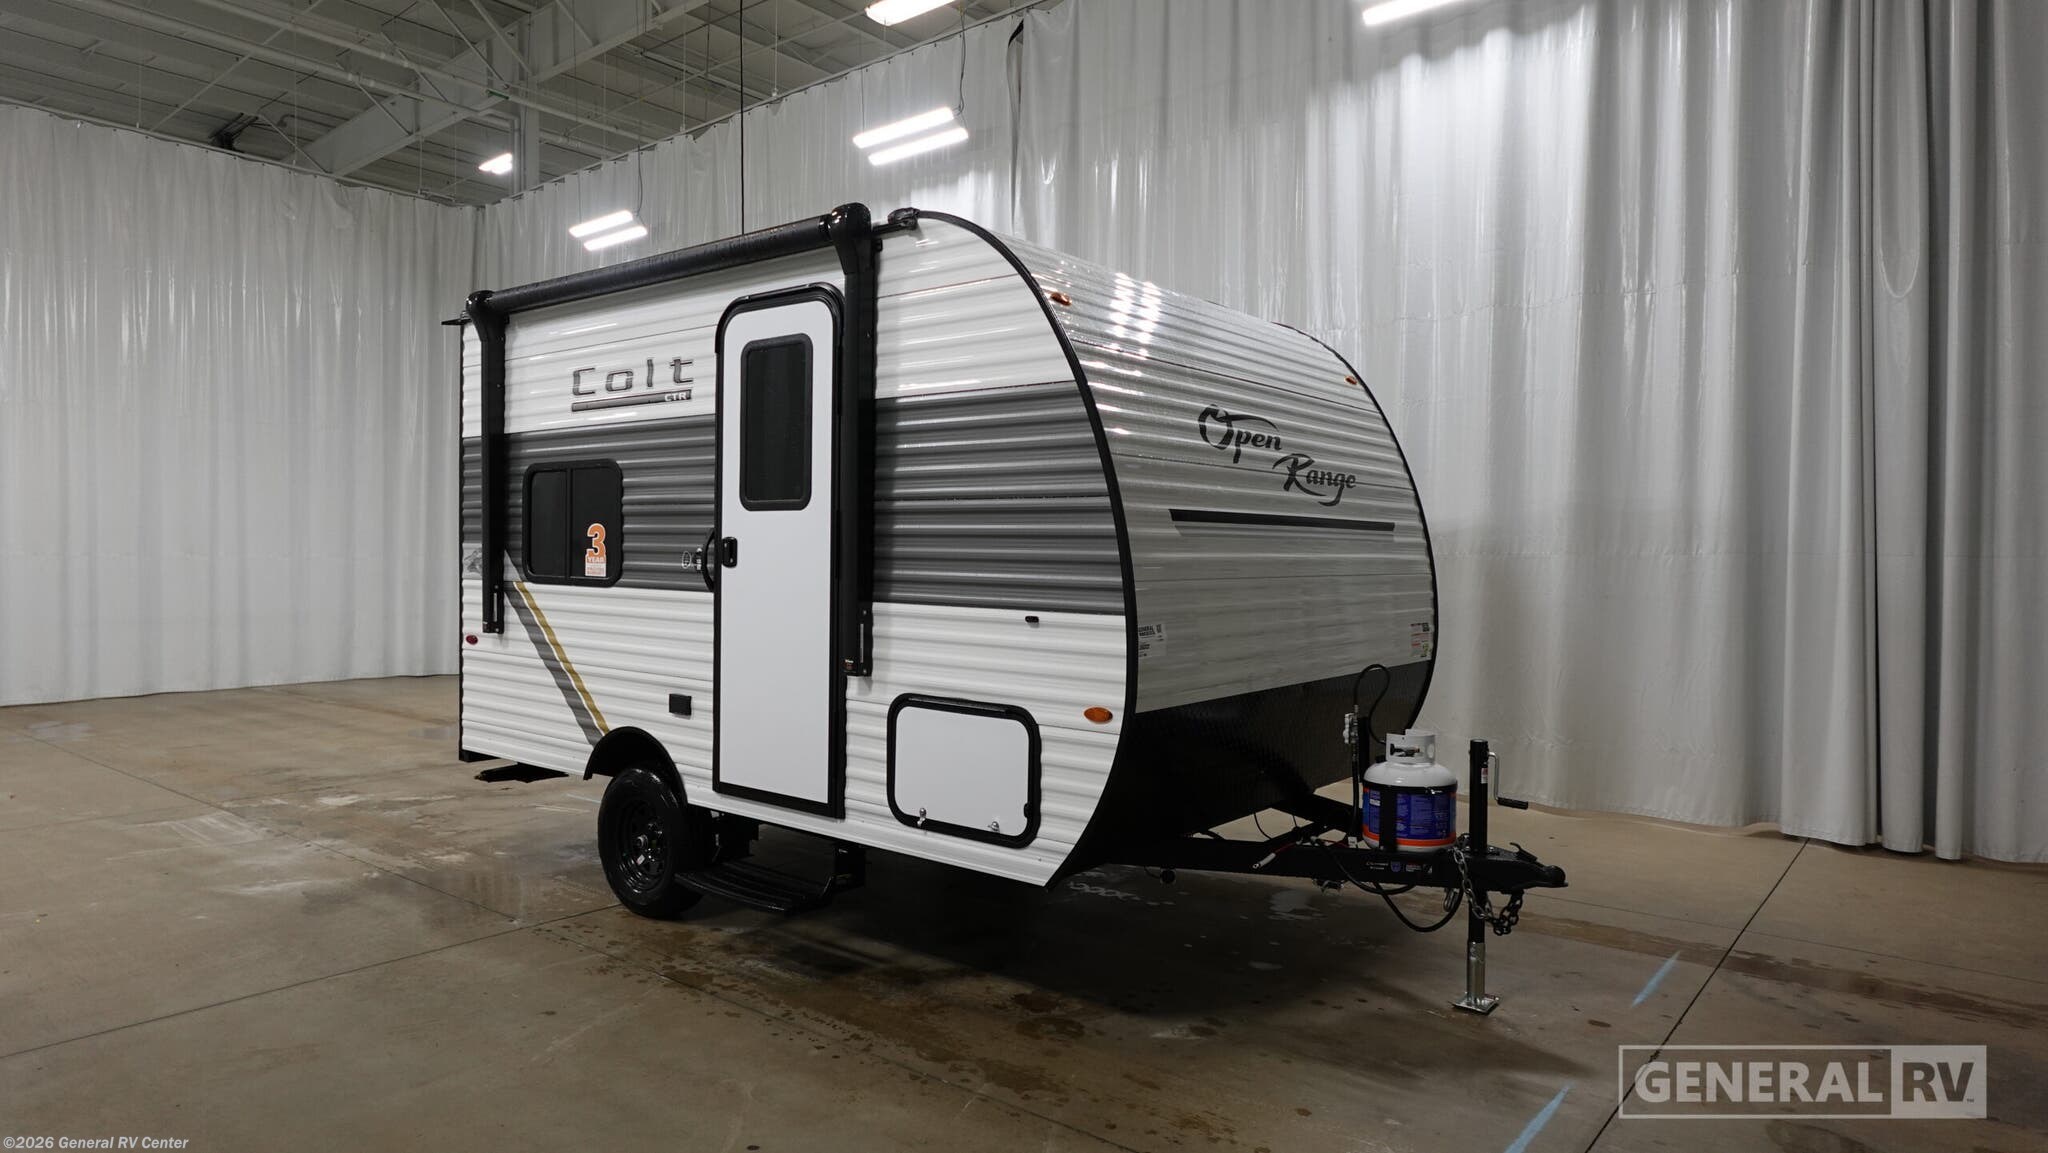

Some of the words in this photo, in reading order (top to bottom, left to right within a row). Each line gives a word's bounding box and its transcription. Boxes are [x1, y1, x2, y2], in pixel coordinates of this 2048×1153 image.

[572, 358, 694, 396] Colt
[664, 391, 687, 402] CTR
[1198, 403, 1283, 464] Open
[1272, 452, 1357, 507] Range
[587, 523, 606, 557] 3
